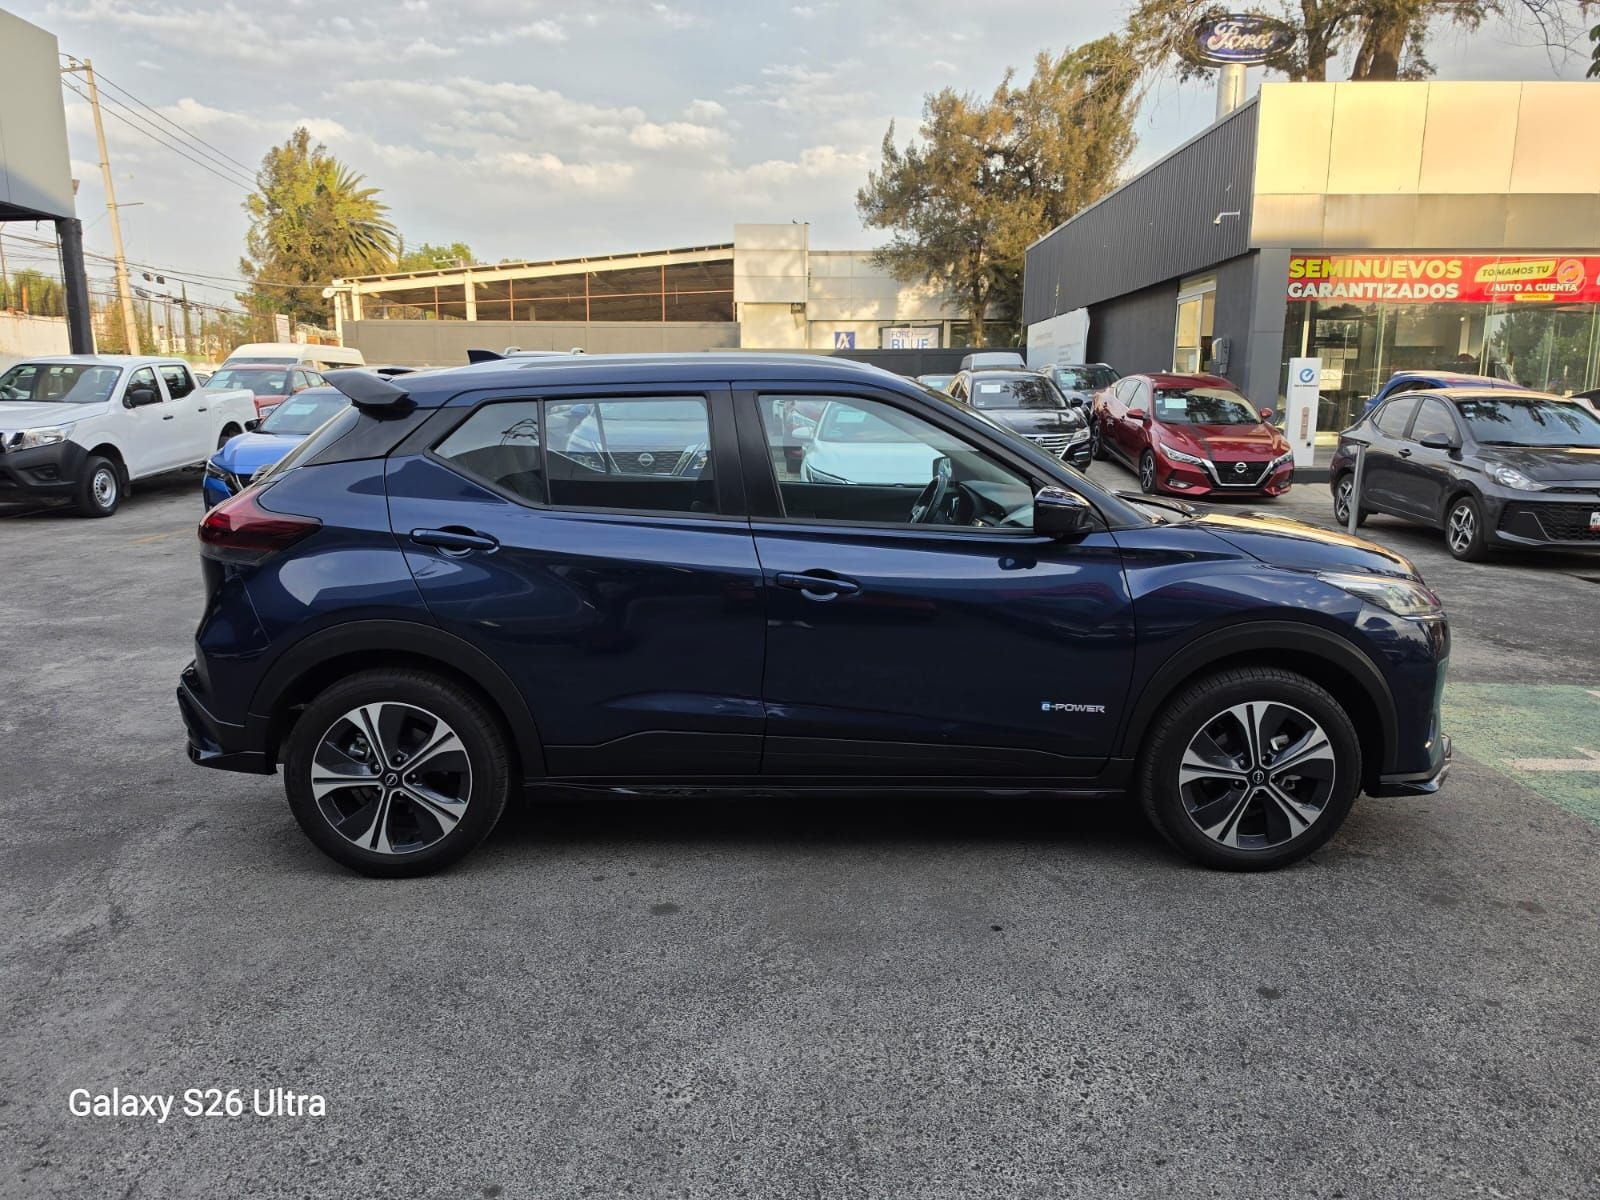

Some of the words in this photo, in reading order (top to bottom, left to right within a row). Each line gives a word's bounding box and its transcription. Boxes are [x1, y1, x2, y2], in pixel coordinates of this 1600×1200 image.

[1207, 21, 1275, 50] Ford
[1289, 259, 1463, 279] SEMINUEVOS
[1482, 266, 1534, 277] TOMAMOS
[1536, 265, 1550, 274] TU
[1287, 282, 1460, 299] GARANTIZADOS
[1491, 283, 1522, 292] AUTO
[1524, 283, 1533, 292] A
[1535, 283, 1578, 292] CUENTA
[1041, 703, 1105, 713] e-POWER
